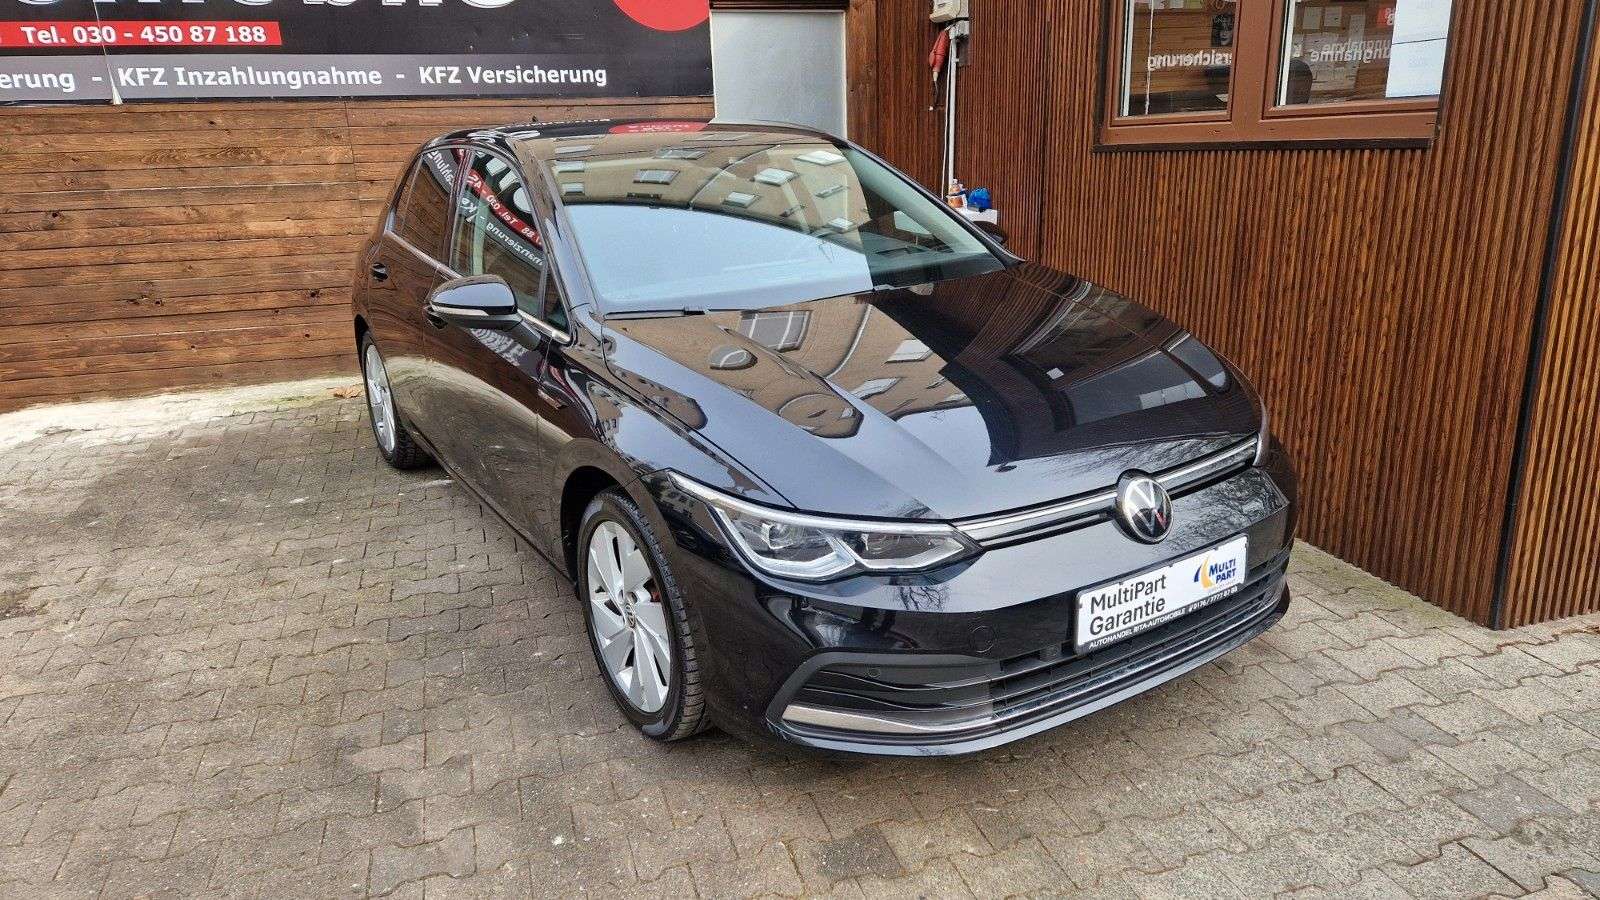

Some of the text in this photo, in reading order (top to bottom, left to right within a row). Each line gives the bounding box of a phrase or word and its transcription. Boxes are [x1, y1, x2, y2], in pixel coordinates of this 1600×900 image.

[20, 26, 66, 43] Tel.
[73, 26, 116, 43] 030
[140, 26, 183, 43] 450
[190, 26, 216, 43] 87
[226, 26, 267, 43] 188
[118, 68, 168, 87] KFZ
[176, 66, 382, 89] Inzahlungnahme
[419, 66, 462, 84] KFZ
[467, 65, 607, 87] Versicherung
[1208, 558, 1236, 577] MULTI
[1215, 567, 1237, 584] PART
[1090, 574, 1167, 614] MultiPart
[1089, 597, 1166, 636] Garantie
[1088, 630, 1133, 649] AUTOHANDEL
